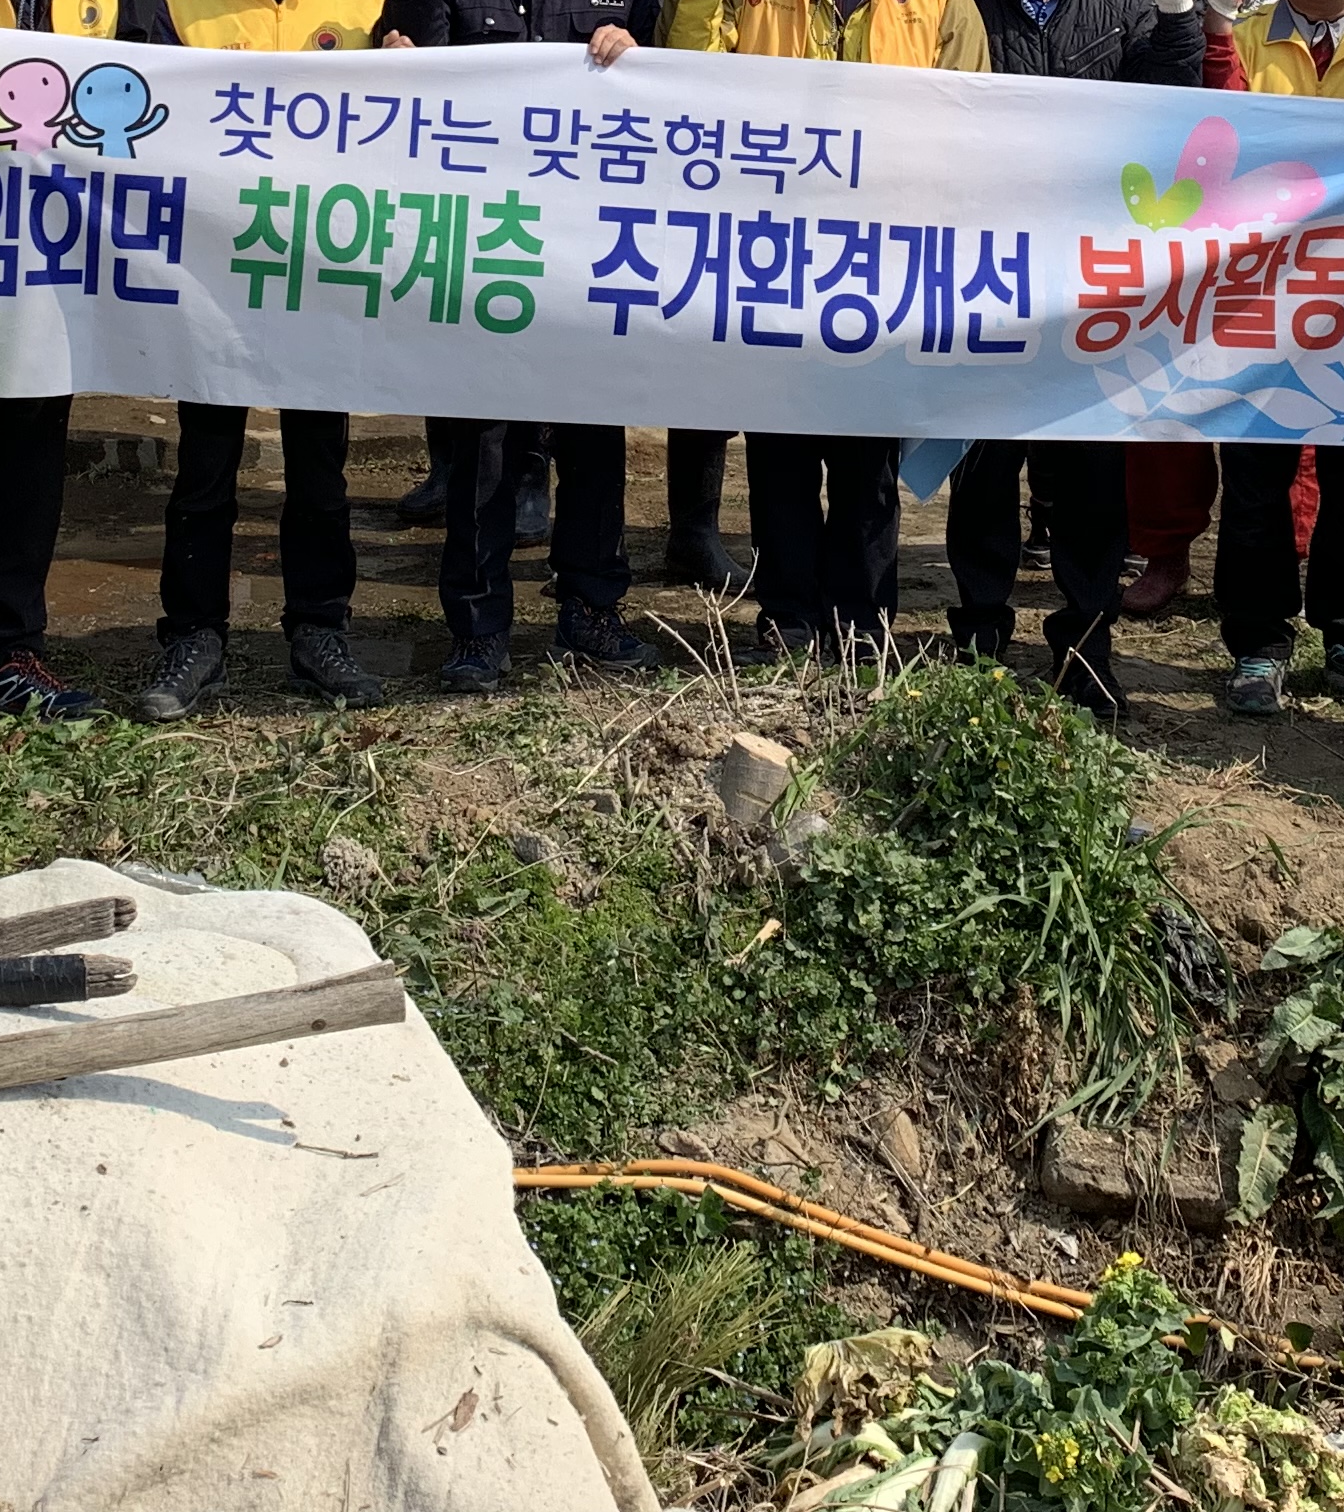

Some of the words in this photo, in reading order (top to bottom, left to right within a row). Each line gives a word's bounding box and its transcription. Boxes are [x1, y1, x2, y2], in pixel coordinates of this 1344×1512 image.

[210, 82, 500, 174] 찾아가는
[522, 106, 862, 195] 맞춤형복지
[229, 176, 545, 335] 취약계층
[586, 204, 1032, 355] 주거환경개선
